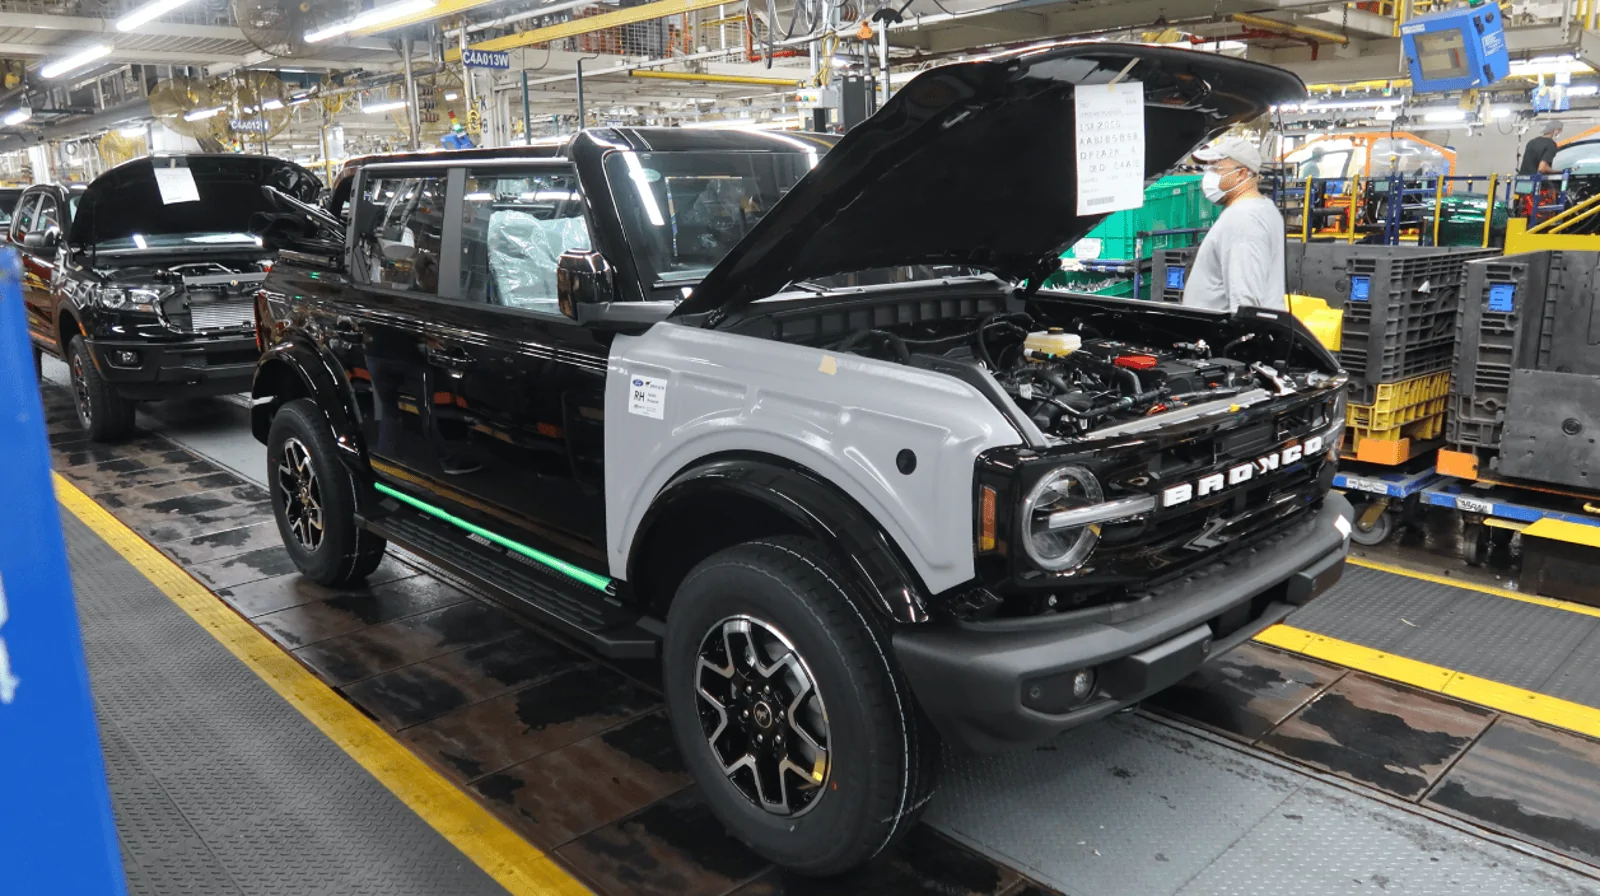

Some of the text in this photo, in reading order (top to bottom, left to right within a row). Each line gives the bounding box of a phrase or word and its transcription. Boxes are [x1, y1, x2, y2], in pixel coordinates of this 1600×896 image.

[463, 51, 509, 67] C4A013W
[634, 390, 645, 403] RH
[1163, 436, 1323, 507] BRONCO
